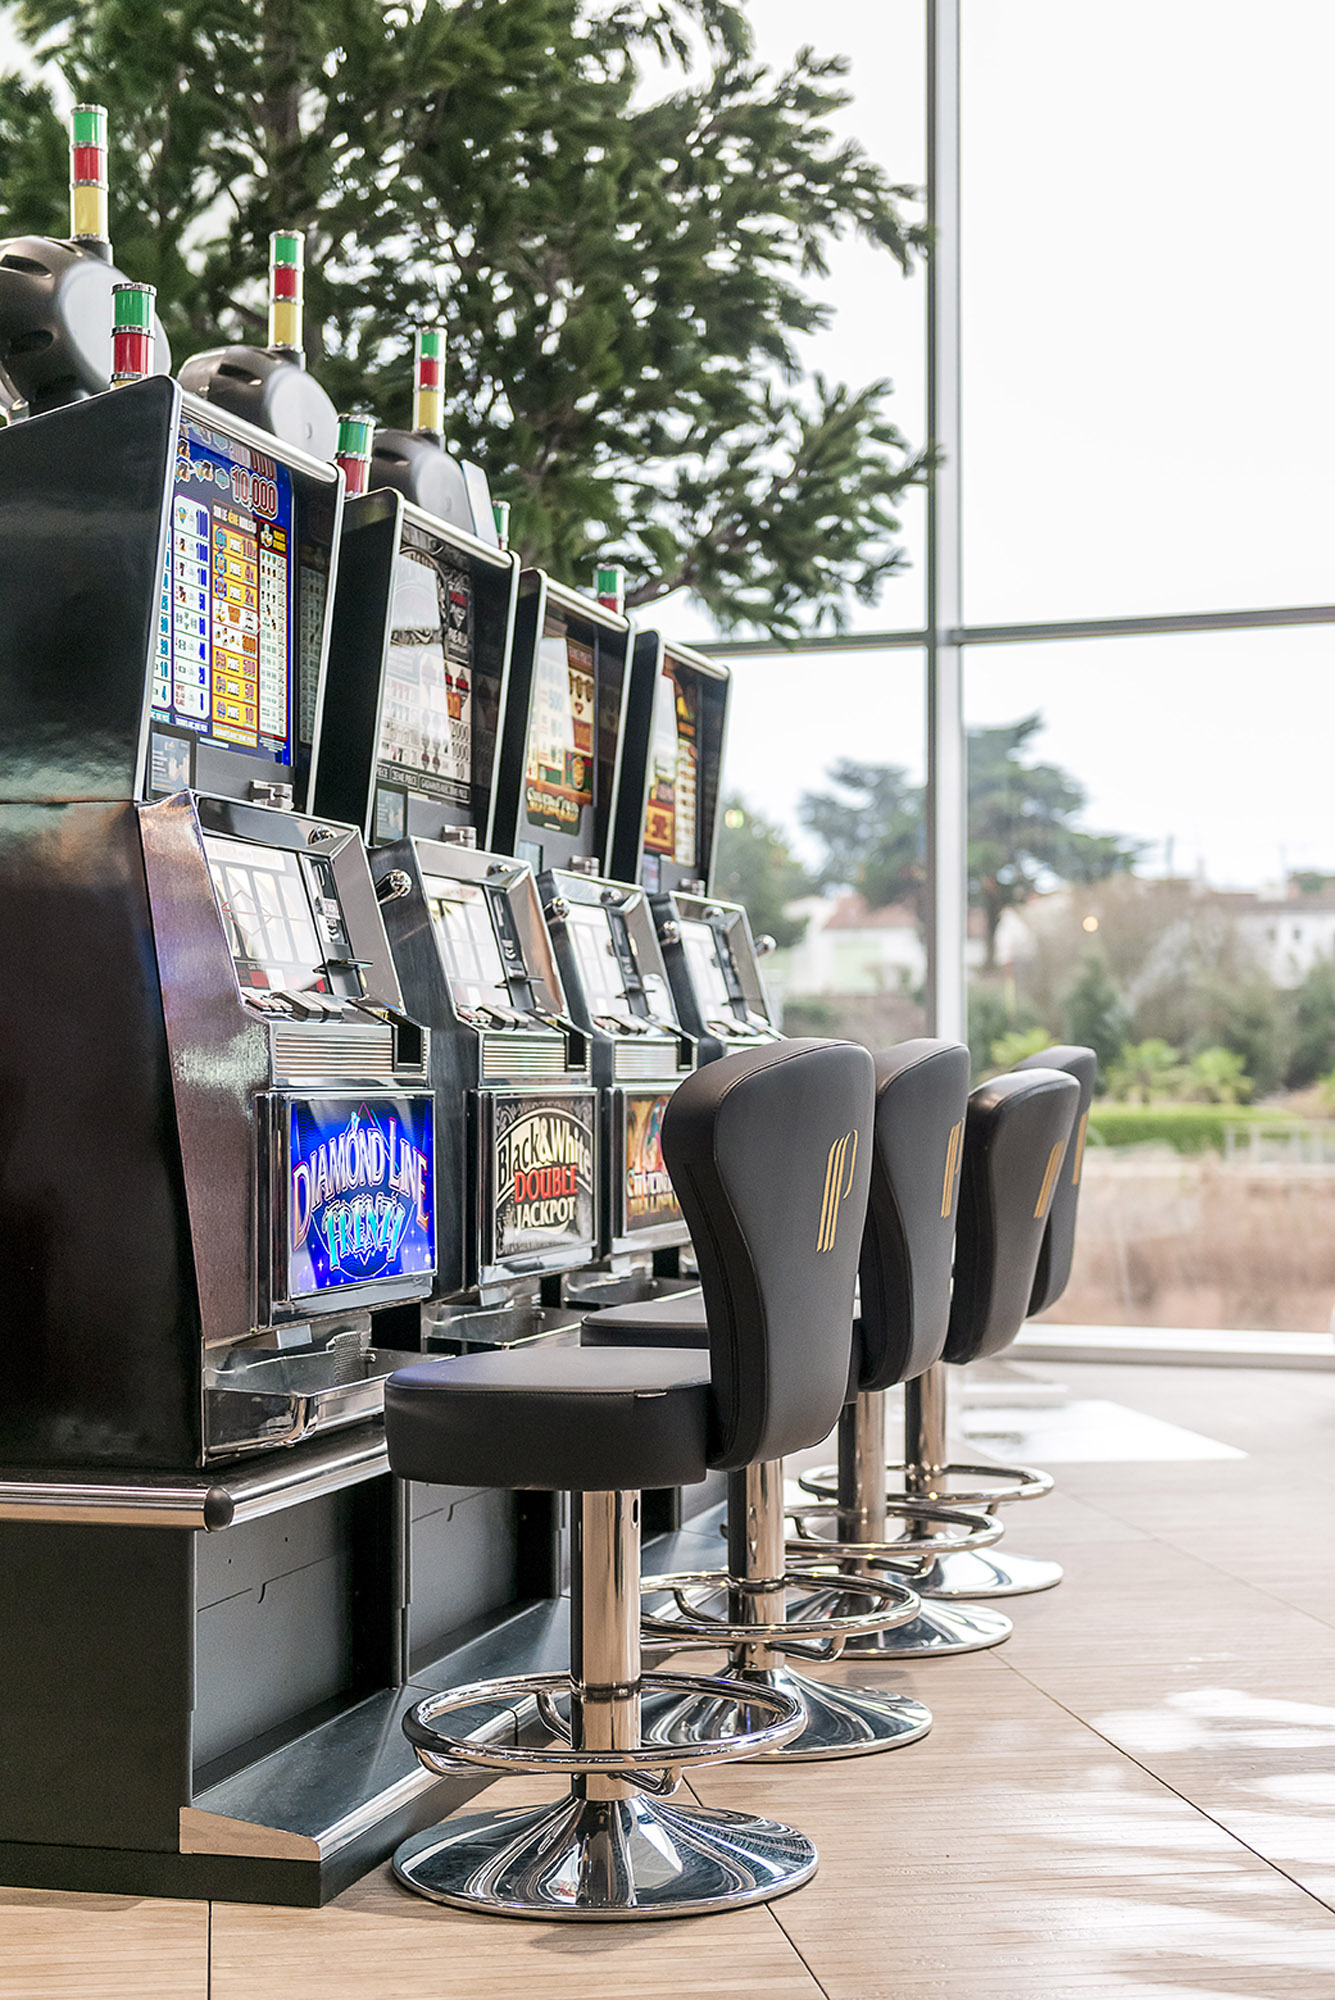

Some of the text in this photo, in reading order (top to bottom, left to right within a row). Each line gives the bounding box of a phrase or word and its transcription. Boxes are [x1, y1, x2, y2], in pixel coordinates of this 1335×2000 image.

[292, 1117, 429, 1251] DIAMOND LINE
[514, 1164, 579, 1203] DOUBLE
[322, 1192, 406, 1271] FRENZY
[516, 1197, 576, 1235] JACKPOT
